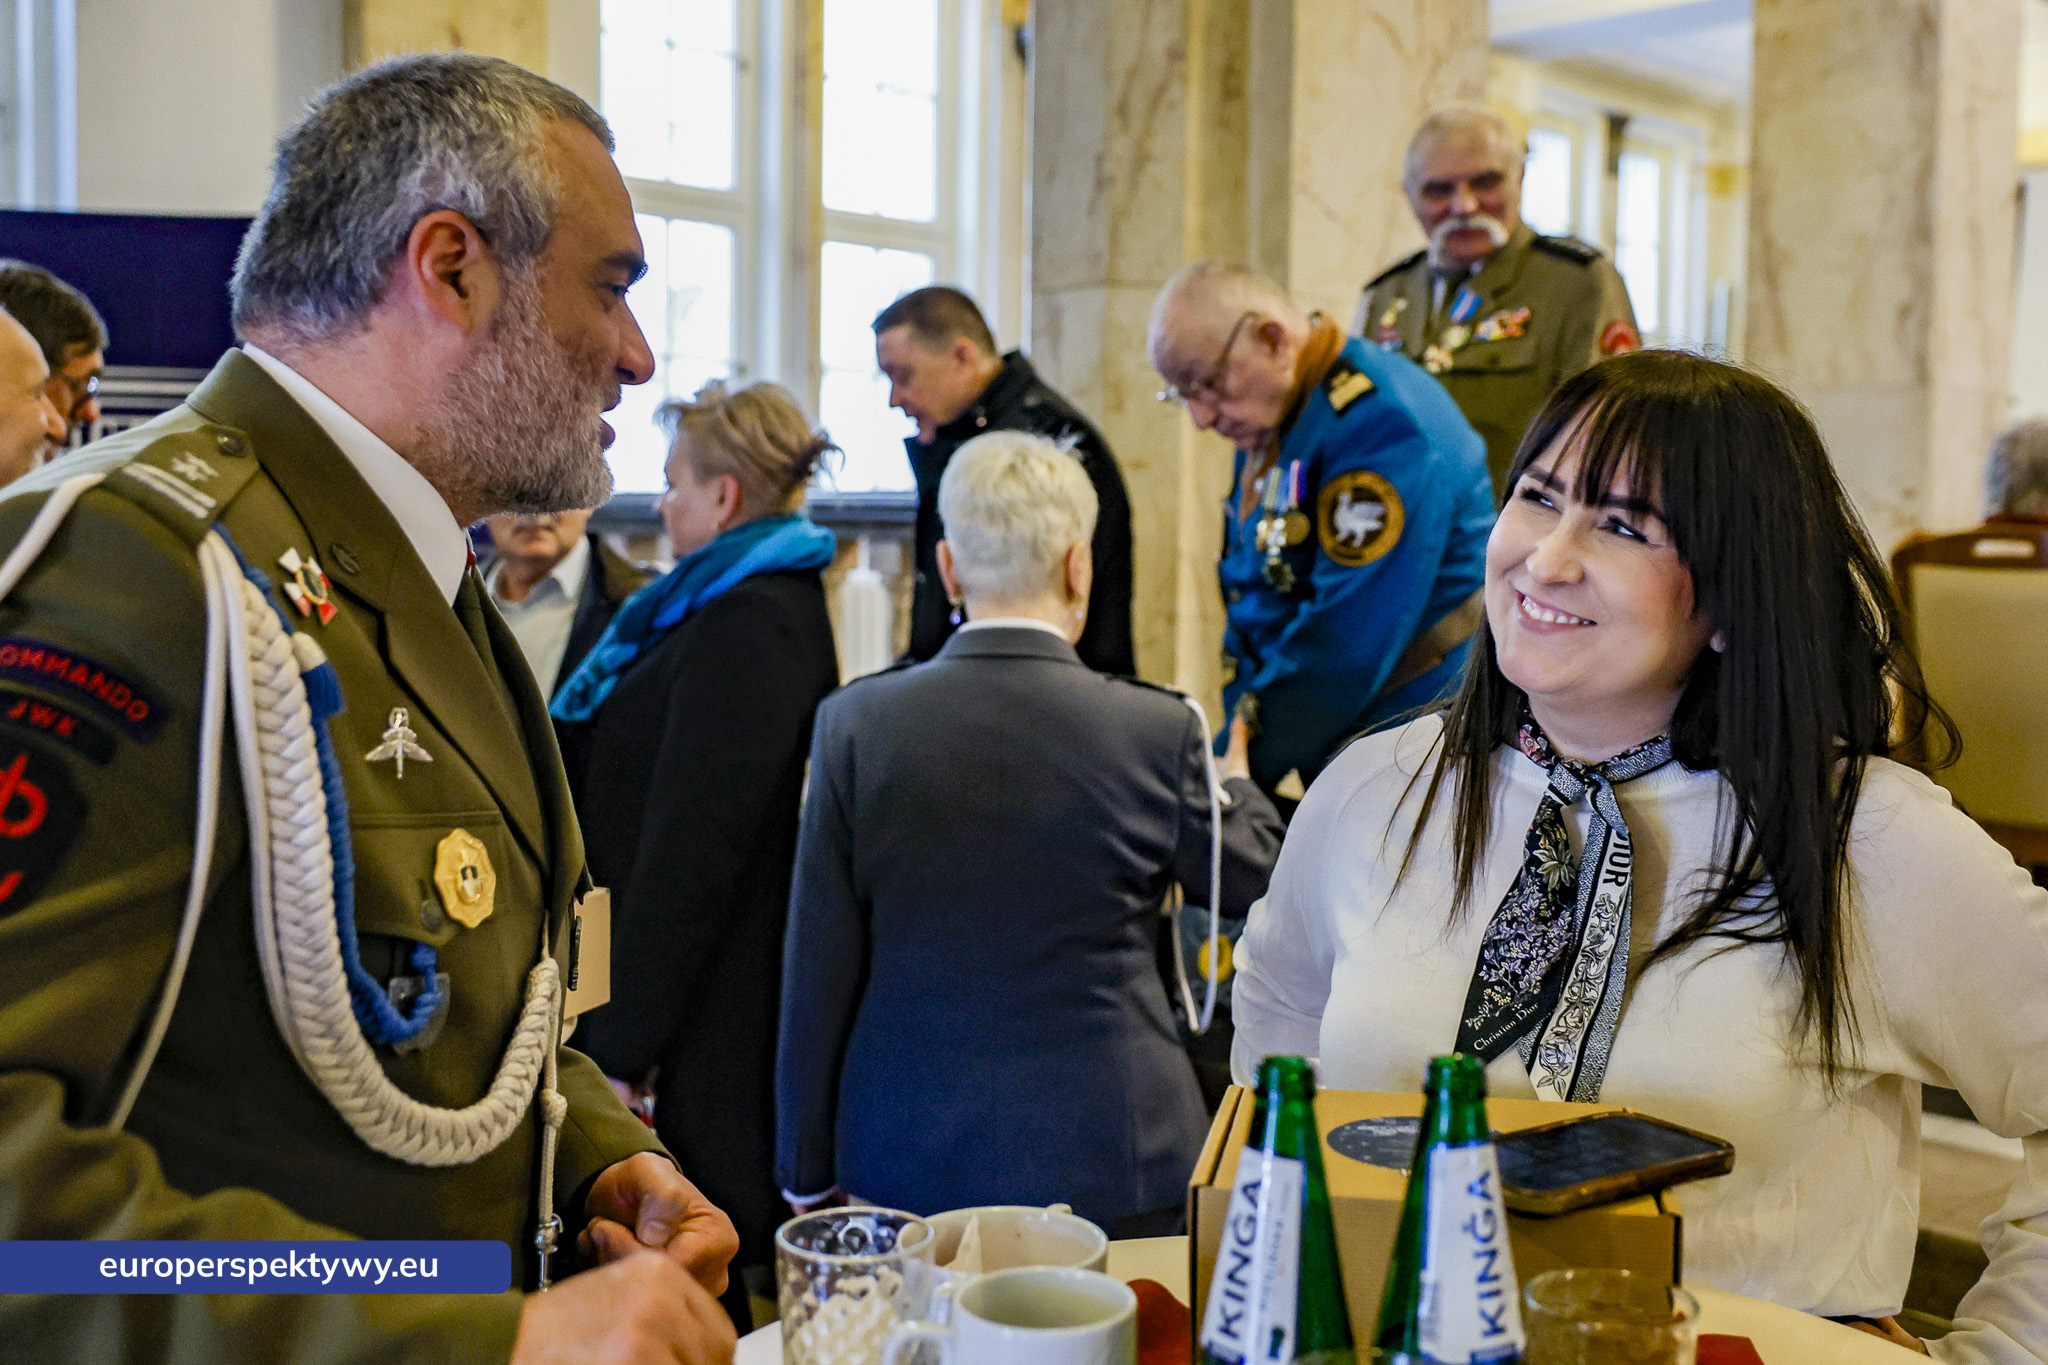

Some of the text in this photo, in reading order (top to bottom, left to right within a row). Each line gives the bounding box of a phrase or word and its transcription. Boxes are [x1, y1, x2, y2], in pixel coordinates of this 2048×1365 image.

[0, 644, 149, 721] OMMANDO
[8, 701, 77, 736] JWK
[1473, 1002, 1539, 1051] Christian Dior
[1217, 1180, 1263, 1340] KINGA
[1466, 1170, 1507, 1338] KINGA
